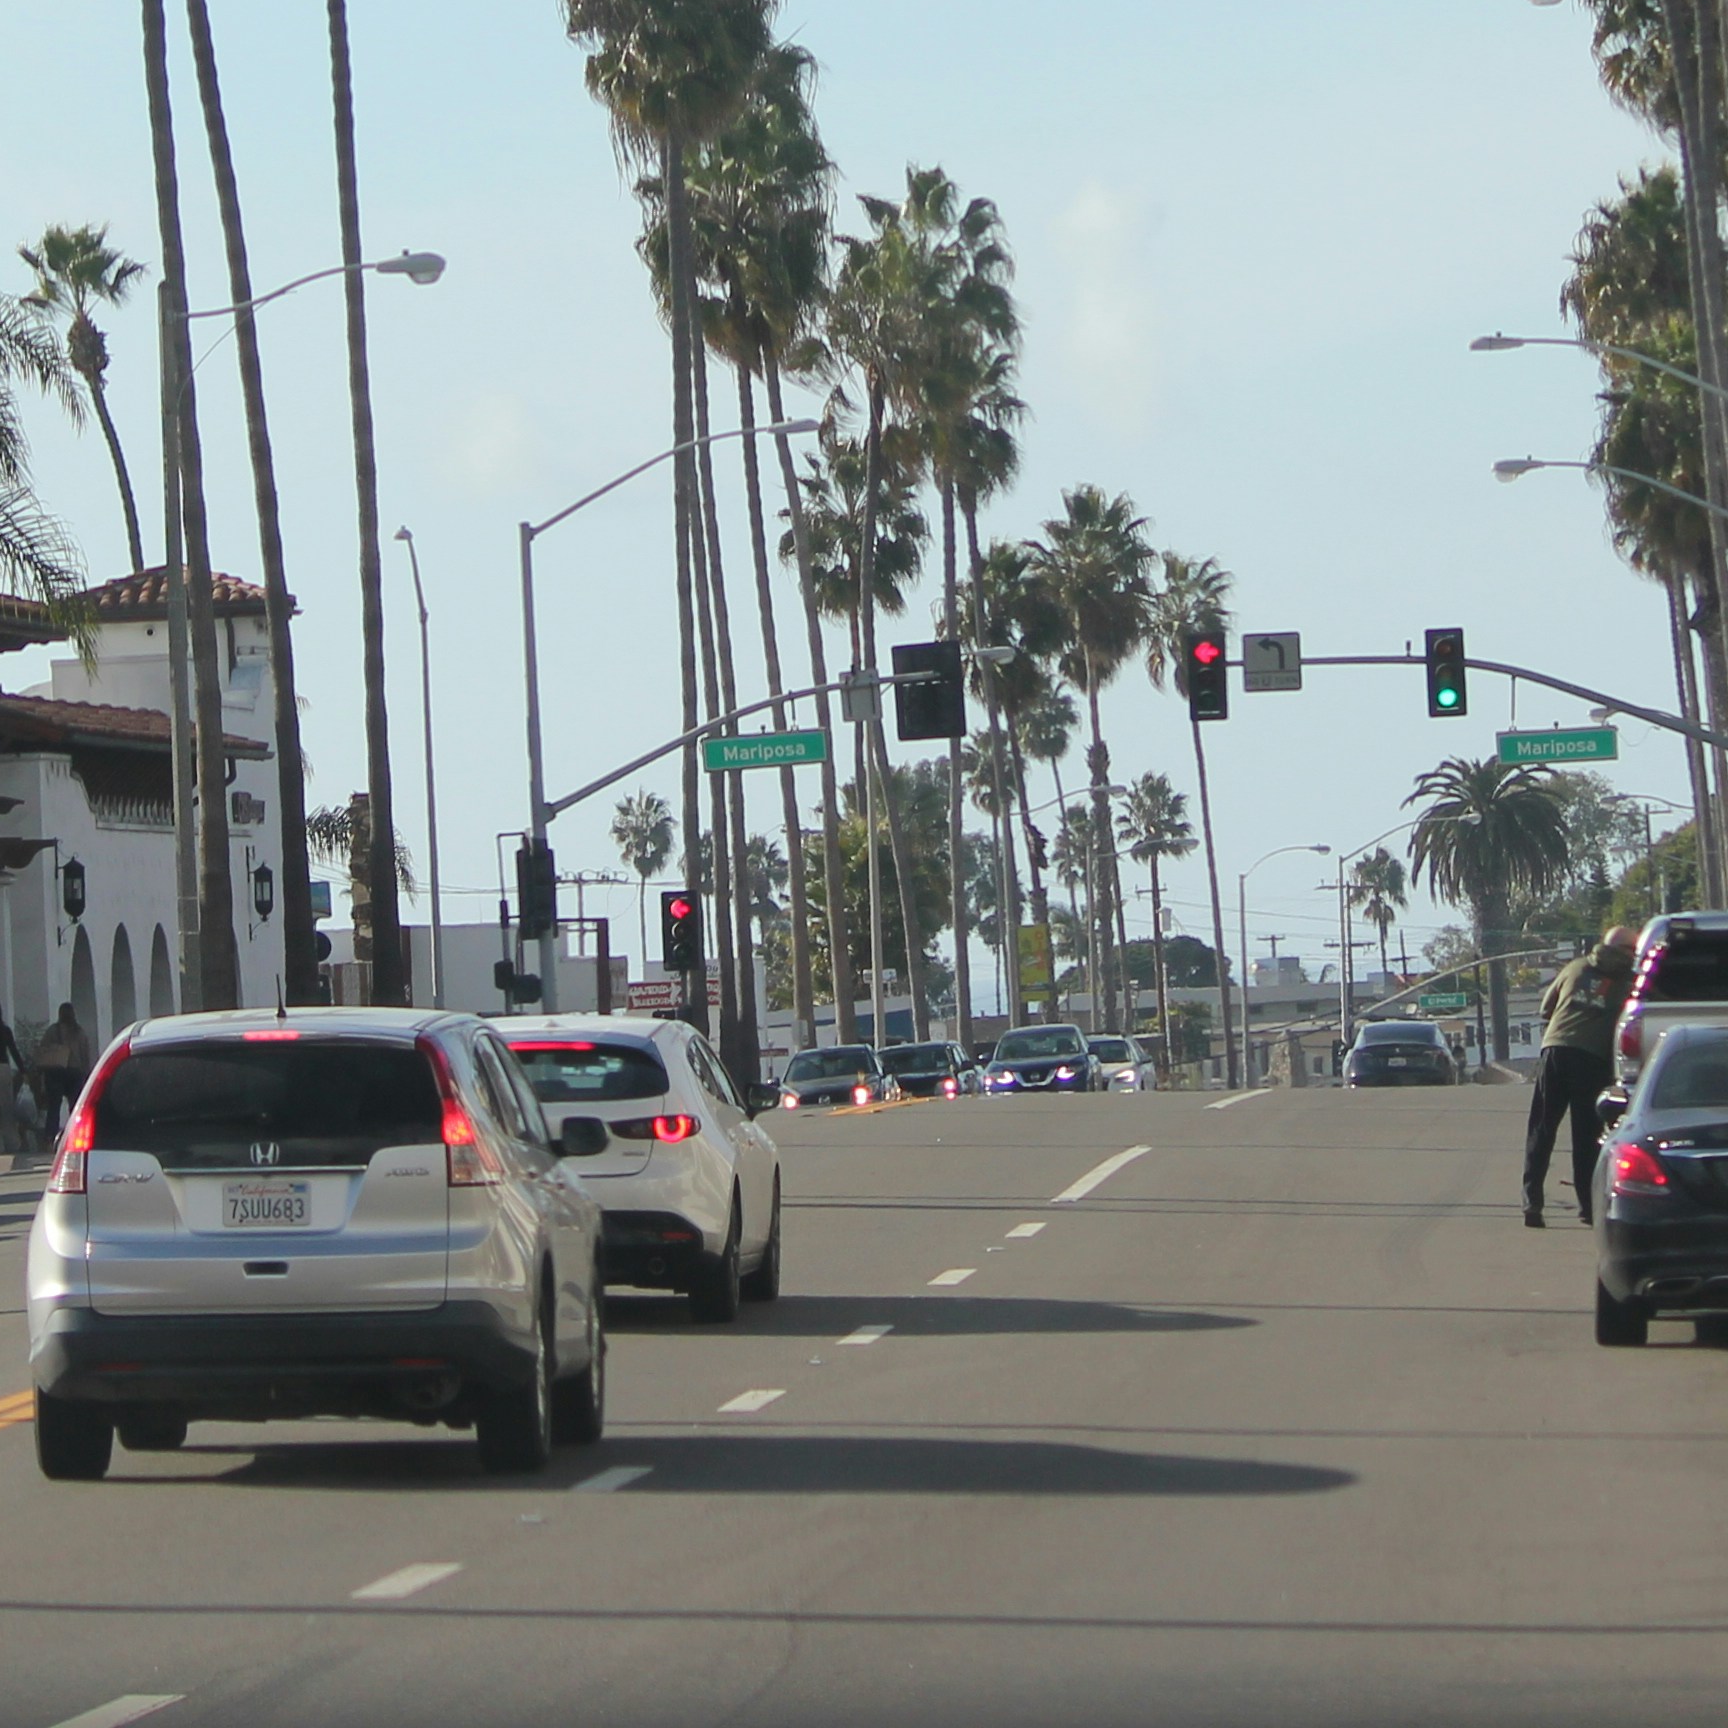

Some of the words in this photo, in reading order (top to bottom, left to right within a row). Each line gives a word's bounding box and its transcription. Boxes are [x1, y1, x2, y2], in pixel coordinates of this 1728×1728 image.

[723, 744, 805, 761] Mariposa
[1517, 740, 1597, 756] Mariposa
[229, 1198, 305, 1220] 7SUU683
